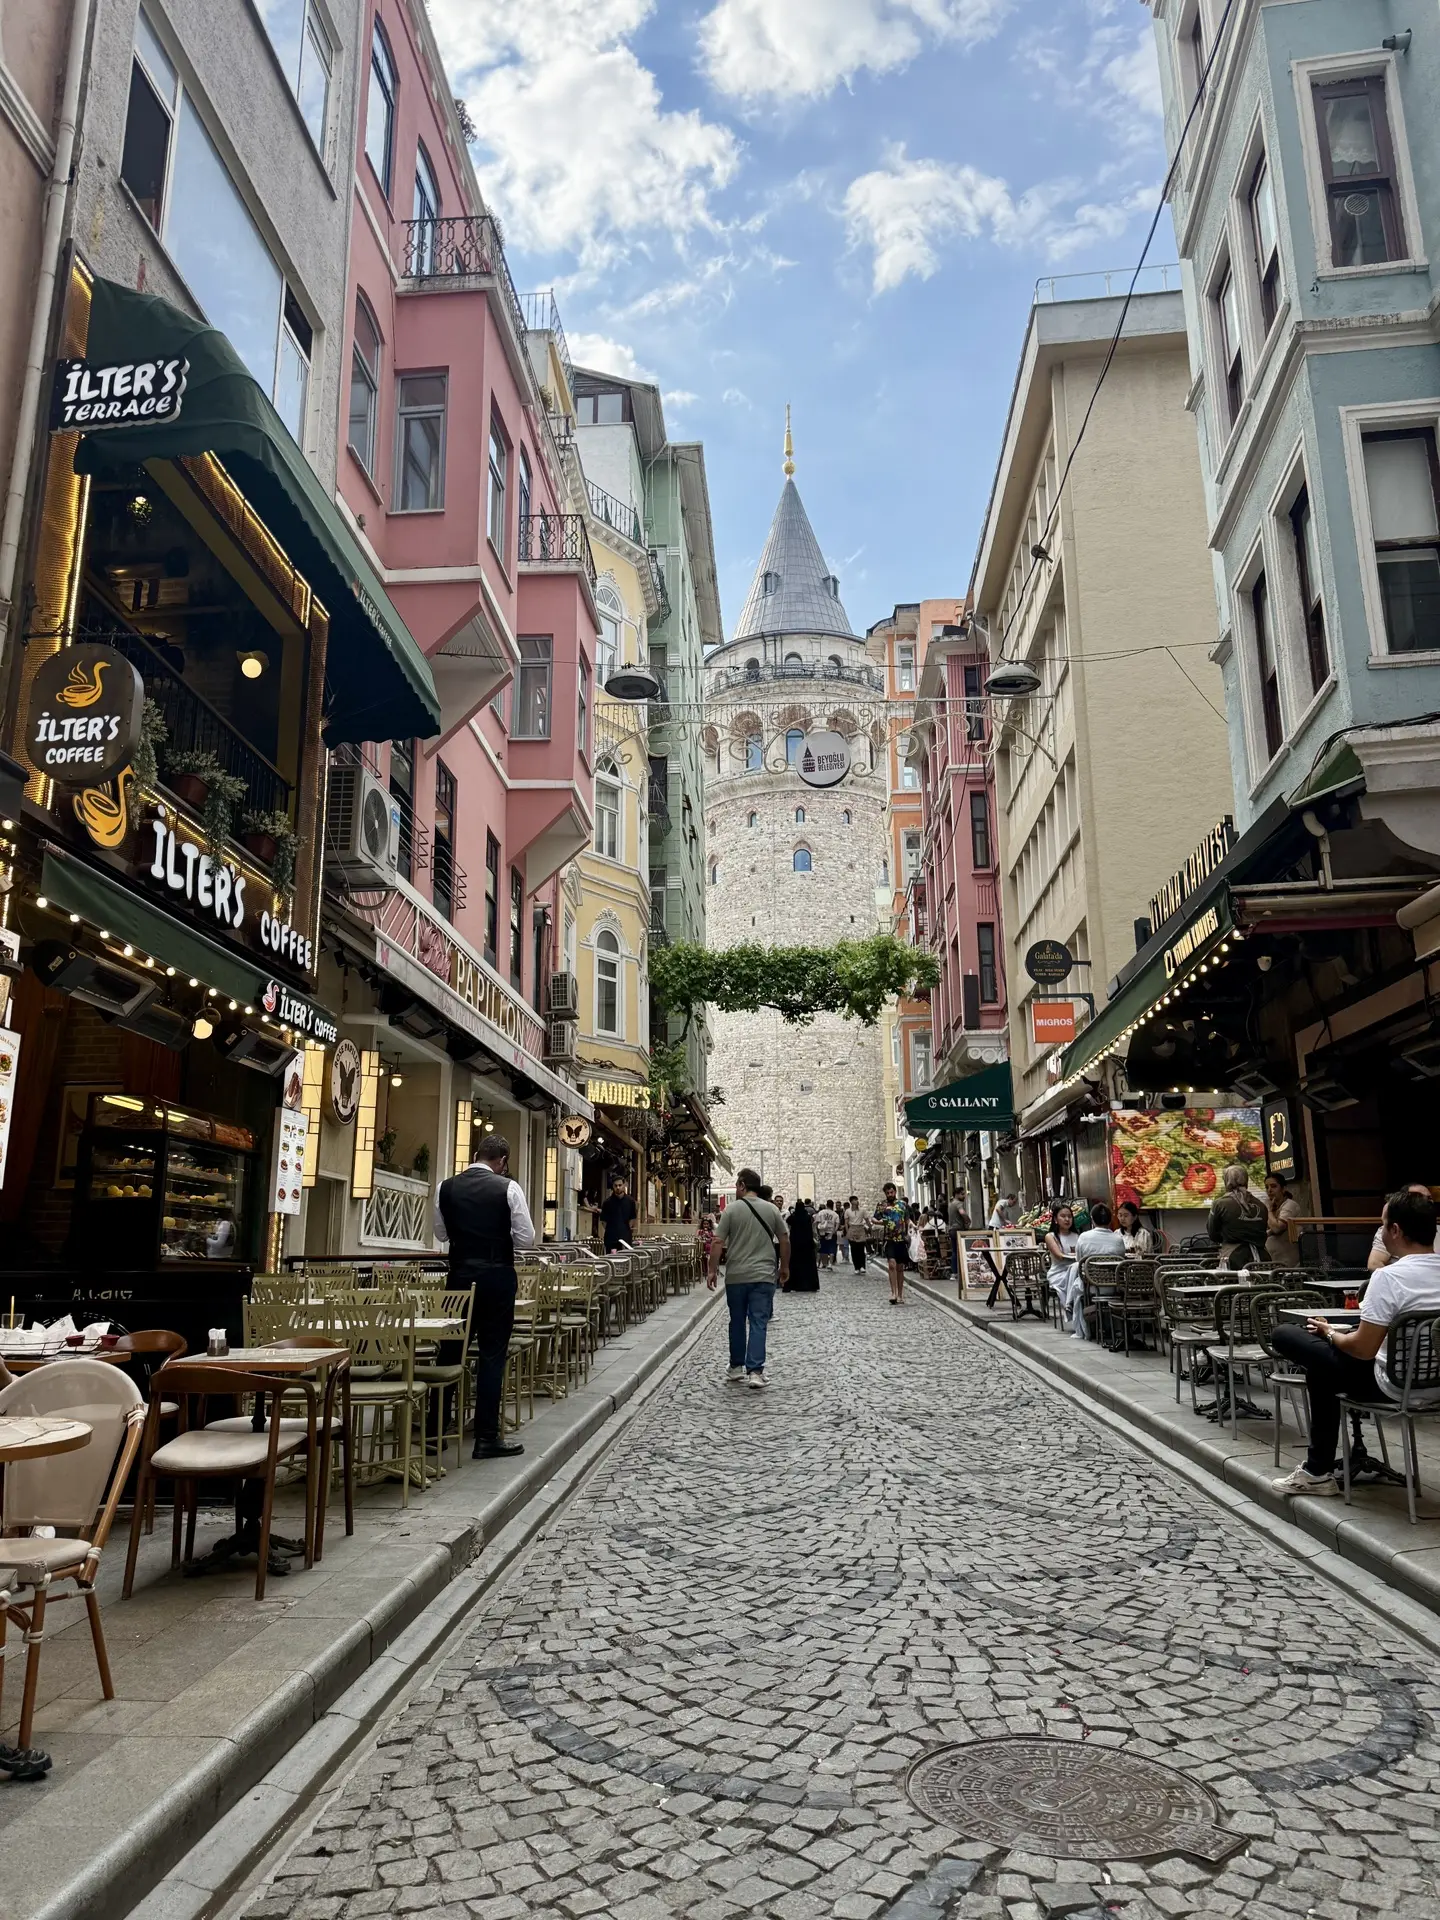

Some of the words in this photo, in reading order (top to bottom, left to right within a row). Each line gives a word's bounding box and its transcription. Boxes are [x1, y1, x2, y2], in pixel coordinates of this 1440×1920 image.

[63, 395, 172, 423] TERRACE
[45, 746, 105, 765] COFFEE
[817, 752, 845, 765] BEYOĞLU
[260, 910, 312, 971] COFFEE
[314, 1017, 338, 1043] COFFEE
[587, 1079, 651, 1110] MADDIE'S
[940, 1098, 999, 1107] GALLANT
